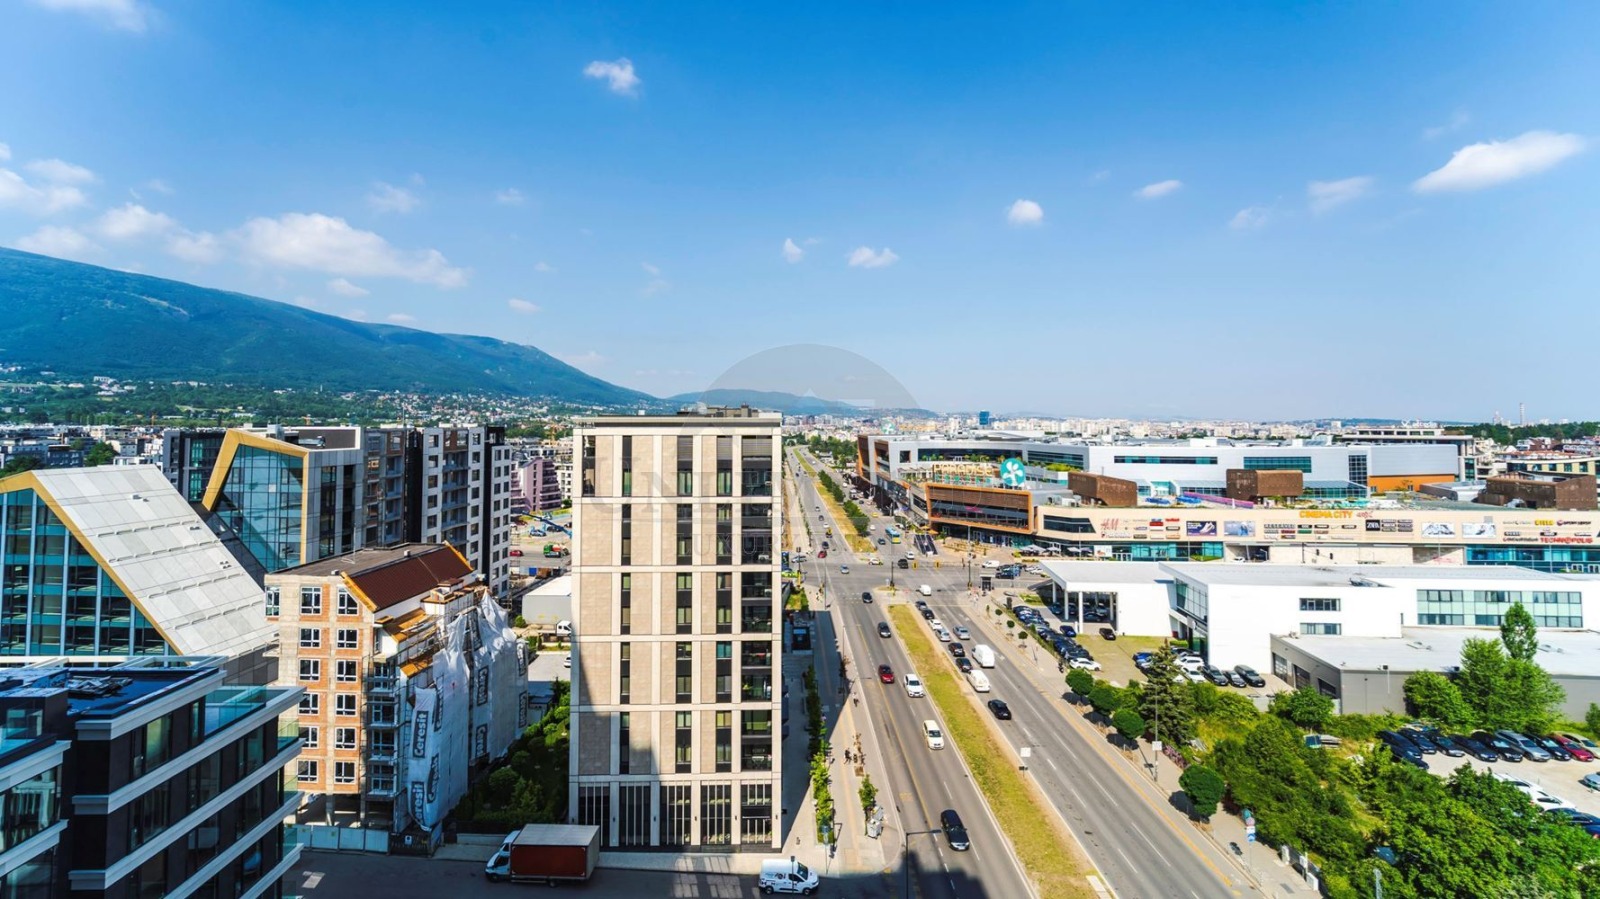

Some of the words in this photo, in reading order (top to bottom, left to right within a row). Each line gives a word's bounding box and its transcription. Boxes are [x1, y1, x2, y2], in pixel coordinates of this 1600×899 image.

[933, 463, 993, 477] PARADISE
[1299, 510, 1332, 519] CINEMA
[1334, 510, 1354, 519] CITY
[414, 712, 427, 757] Ceresit
[476, 726, 486, 756] Ceres
